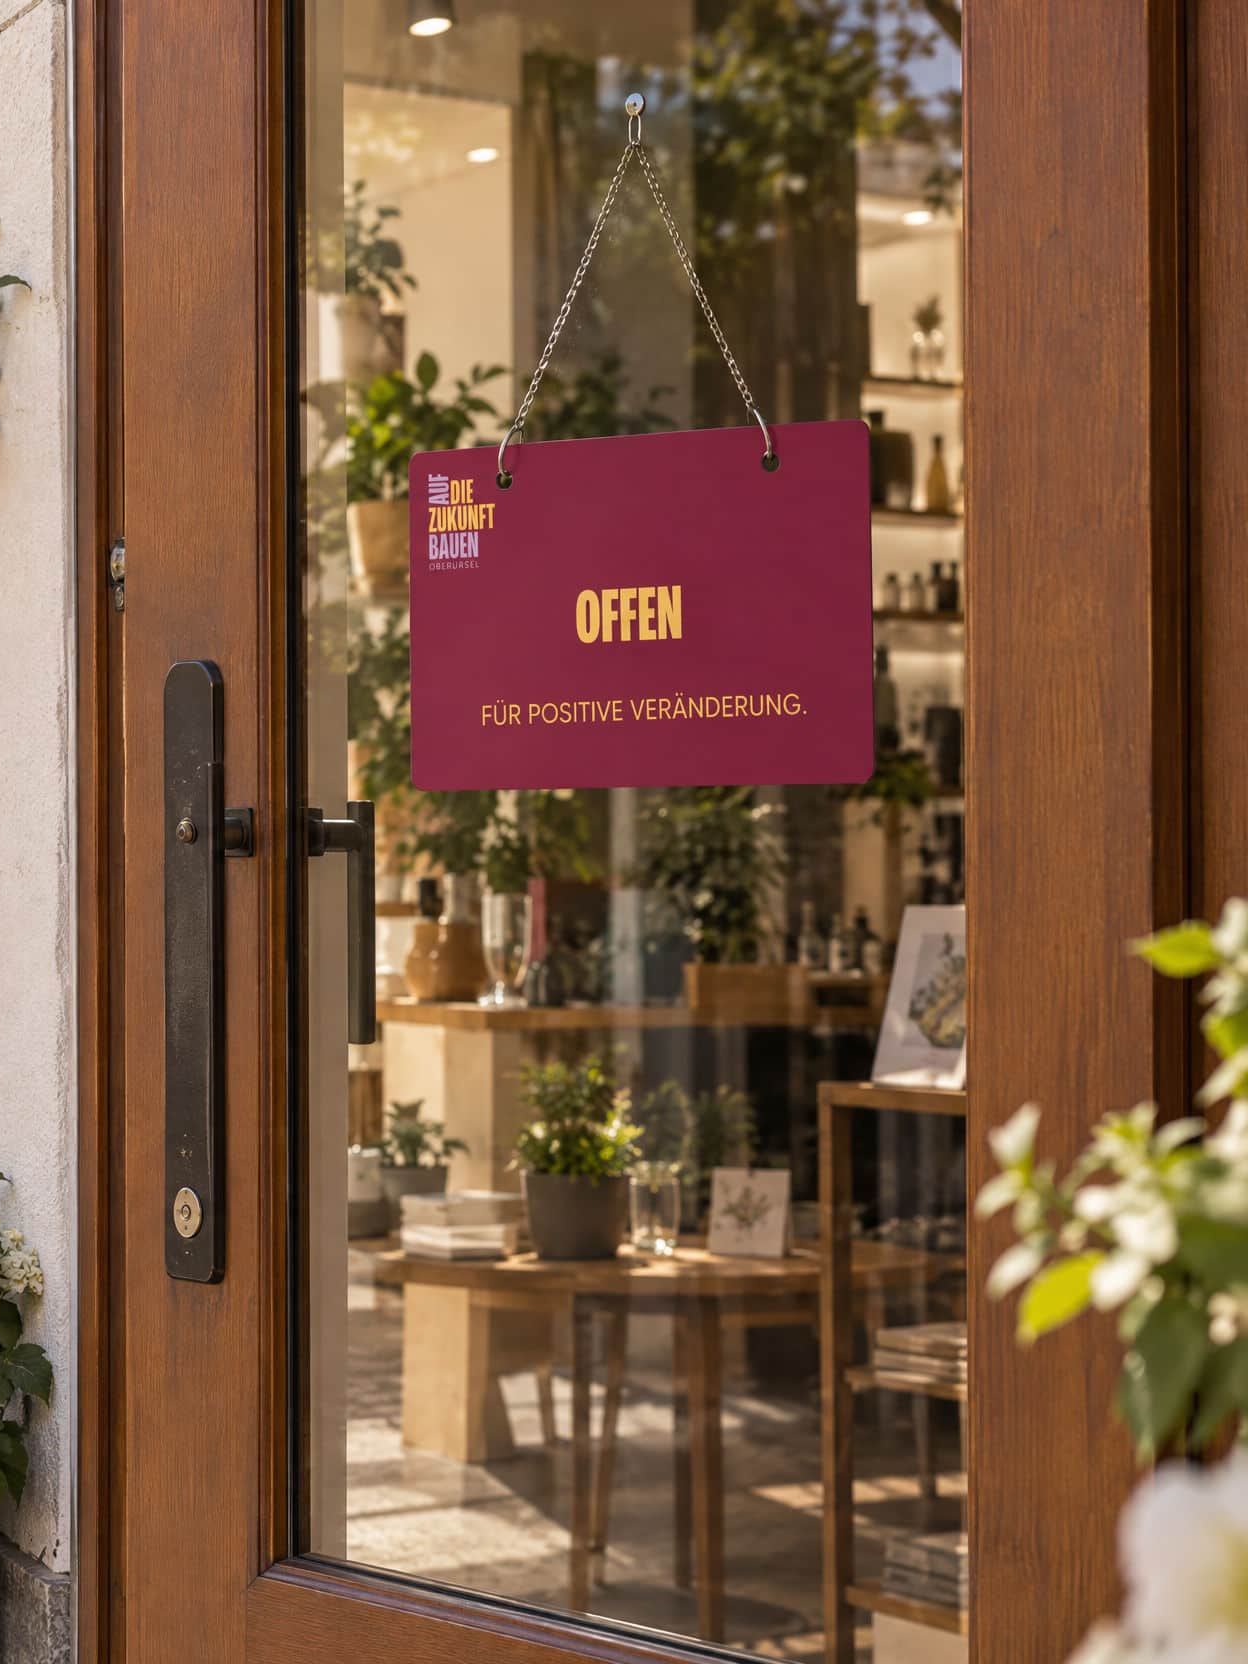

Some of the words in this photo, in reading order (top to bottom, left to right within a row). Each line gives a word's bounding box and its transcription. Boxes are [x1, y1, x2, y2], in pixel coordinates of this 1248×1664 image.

[428, 474, 449, 505] AUF
[450, 479, 474, 505] DIE
[428, 503, 495, 533] ZUKUNFT
[429, 531, 479, 560] BAUEN
[575, 585, 683, 644] OFFEN
[481, 699, 521, 726] FÜR
[528, 699, 624, 724] POSITIVE
[630, 692, 808, 720] VERÄNDERUNG.
